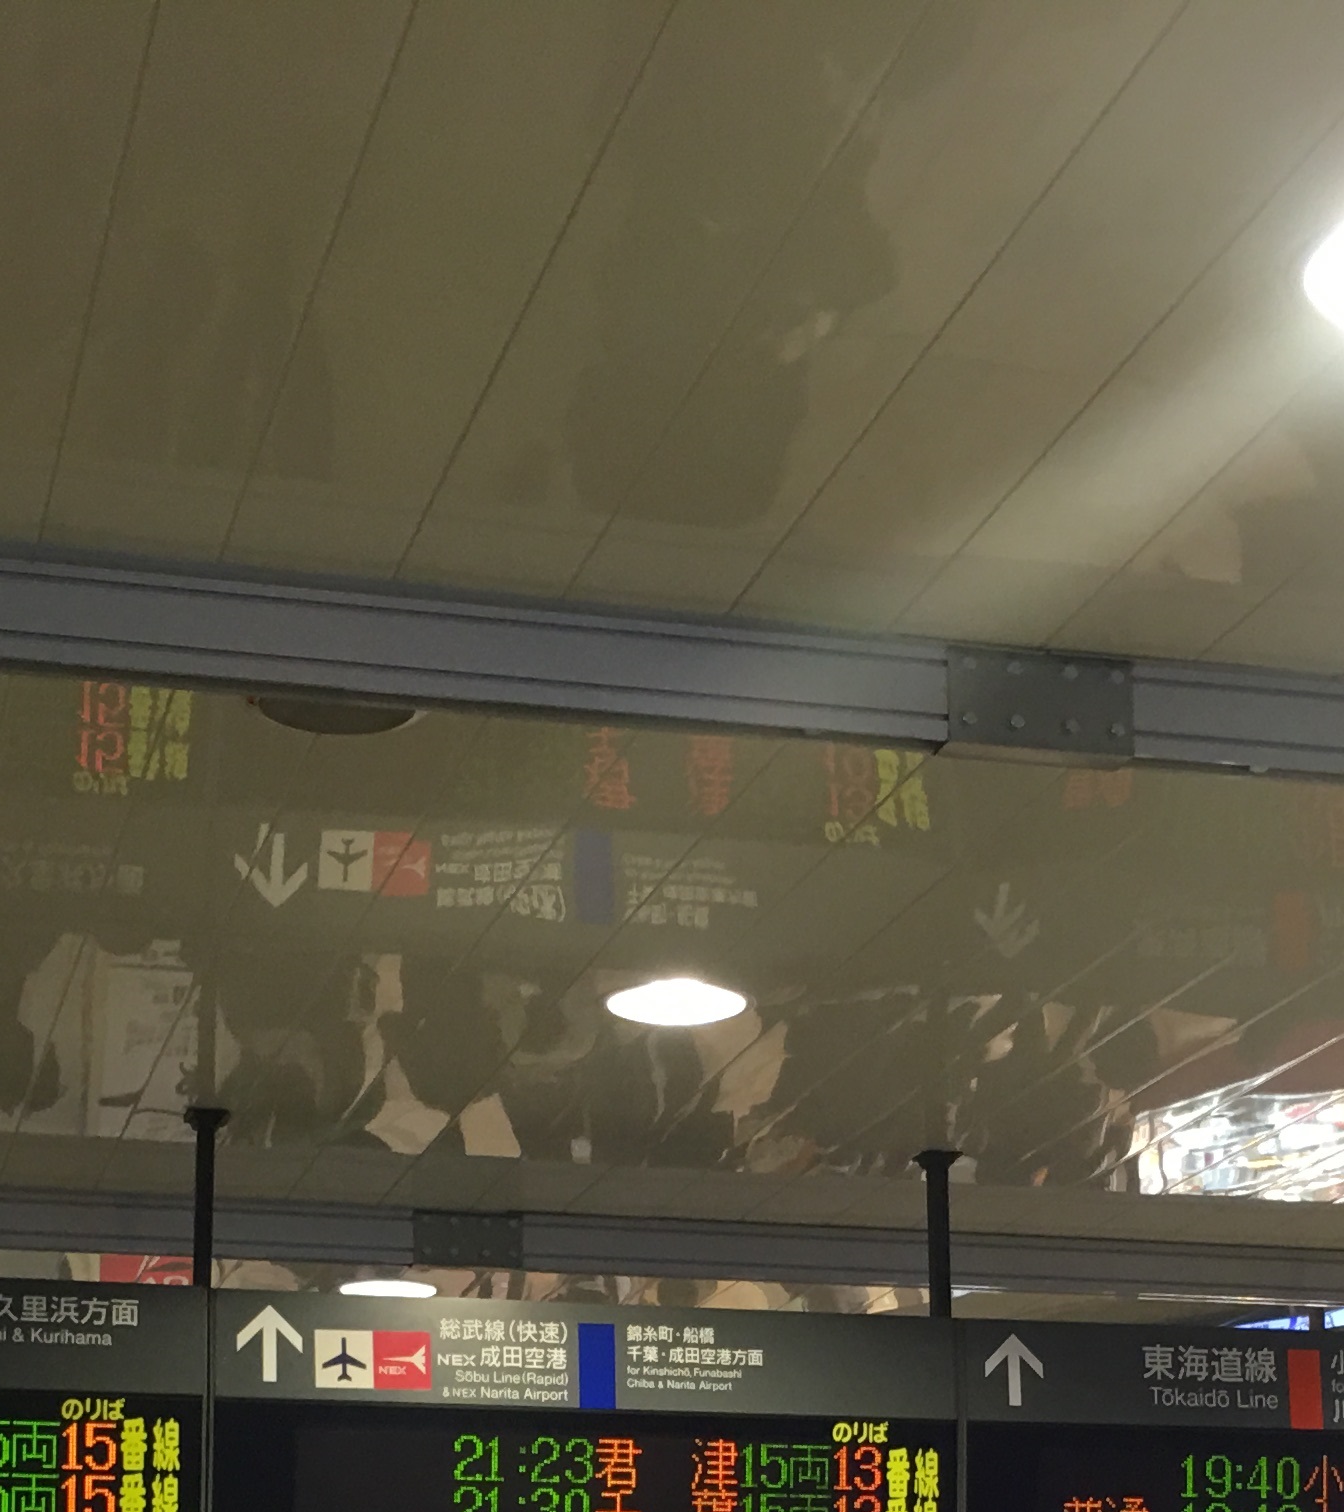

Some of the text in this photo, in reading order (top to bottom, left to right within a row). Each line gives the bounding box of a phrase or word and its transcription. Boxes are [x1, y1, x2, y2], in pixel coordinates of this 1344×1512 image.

[12, 1329, 25, 1343] &
[31, 1329, 112, 1347] Kurihama
[440, 1317, 568, 1345] 総武線(快速)
[626, 1324, 714, 1345] 錦糸町・船橋
[480, 1345, 567, 1370] 成田空港
[626, 1345, 764, 1367] 千葉・成田空港方面
[1141, 1344, 1278, 1384] 東海道線
[626, 1365, 640, 1376] for
[693, 1367, 742, 1379] Funabashi
[481, 1388, 520, 1401] Narita
[524, 1389, 569, 1403] Airport
[626, 1378, 655, 1389] Chiba
[667, 1380, 696, 1390] Narita
[699, 1380, 733, 1392] Airport
[1150, 1385, 1278, 1410] Tōkaidō Line
[62, 1398, 125, 1420] のりば
[832, 1422, 888, 1444] のりば
[1181, 1454, 1300, 1499] 19:40
